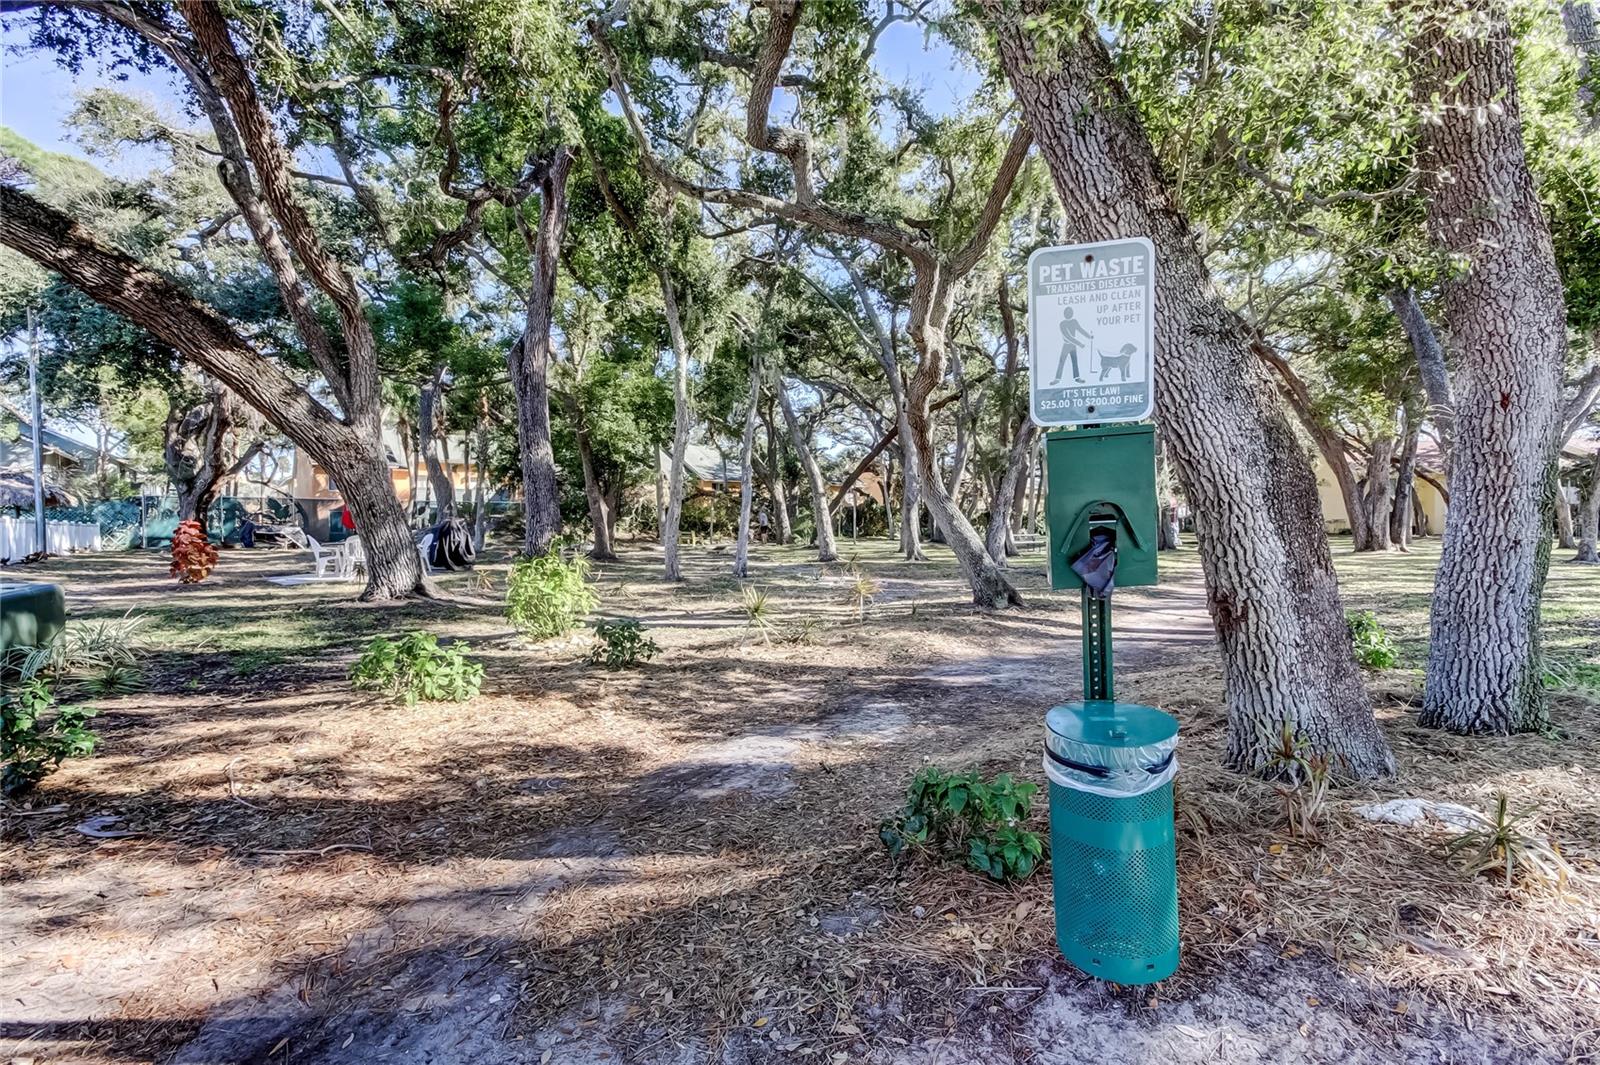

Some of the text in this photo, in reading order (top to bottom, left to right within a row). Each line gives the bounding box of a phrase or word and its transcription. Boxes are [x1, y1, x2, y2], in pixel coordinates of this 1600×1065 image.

[1040, 256, 1144, 282] PET WASTE
[1046, 277, 1137, 295] TRANSMITS DISEASE
[1058, 289, 1140, 305] LEASH AND CLEAN
[1096, 301, 1141, 314] UP AFTER
[1096, 313, 1141, 326] YOUR PET
[1063, 386, 1120, 398] IT'S THE LAW!
[1041, 394, 1144, 409] $25.00 TO $200.00 FINE
